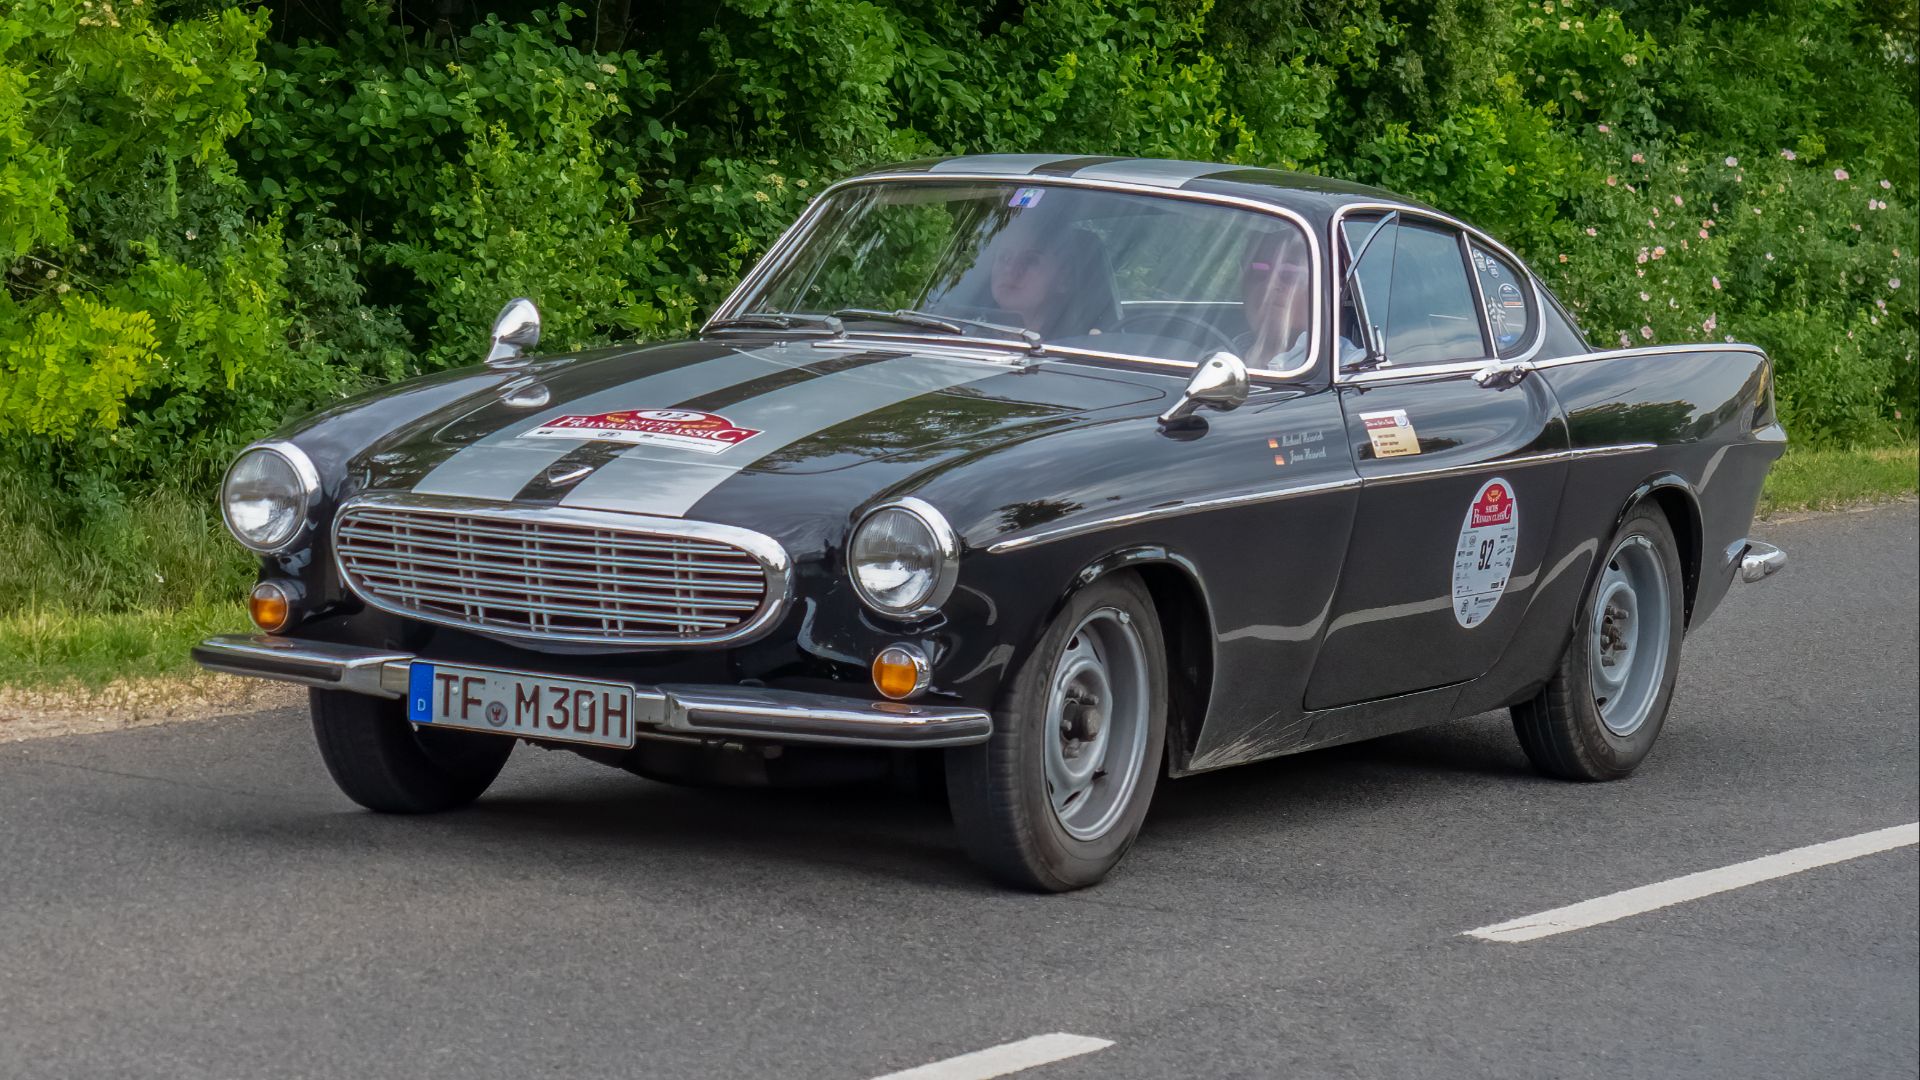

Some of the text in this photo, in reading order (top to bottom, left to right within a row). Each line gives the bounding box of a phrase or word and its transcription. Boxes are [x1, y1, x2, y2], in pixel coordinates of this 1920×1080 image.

[552, 416, 646, 431] FRANKEN
[646, 426, 748, 441] CLASSIC
[655, 411, 692, 421] 92
[1478, 539, 1495, 570] 92
[417, 698, 427, 712] D
[435, 672, 487, 720] TF
